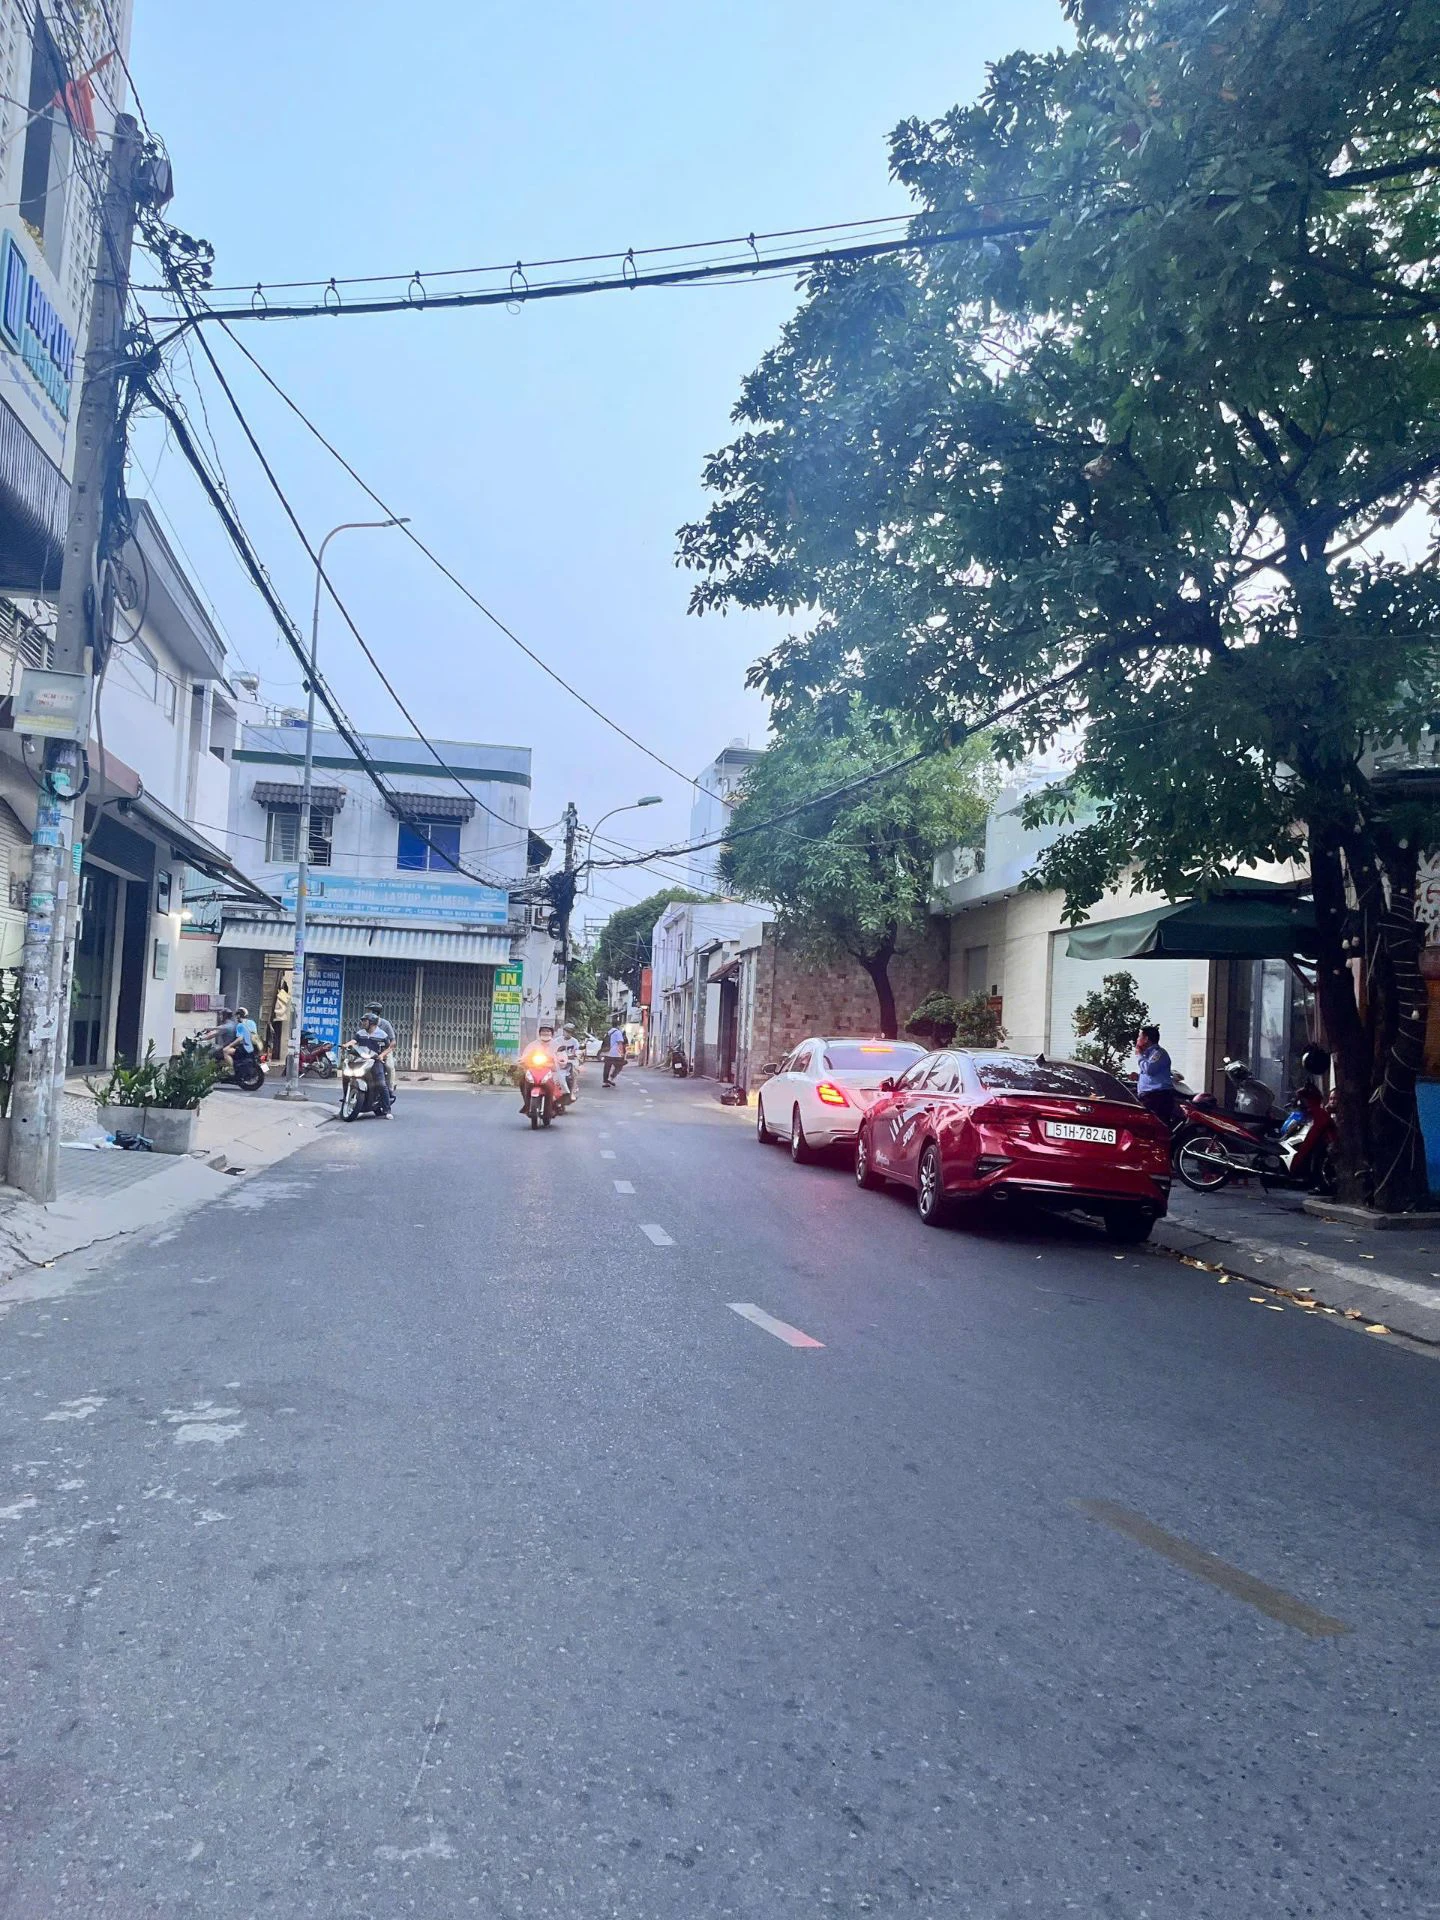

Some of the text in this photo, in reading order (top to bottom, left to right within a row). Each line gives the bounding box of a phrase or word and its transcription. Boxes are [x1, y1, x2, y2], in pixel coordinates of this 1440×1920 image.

[430, 895, 469, 907] CAMERA
[500, 972, 517, 985] IN
[305, 1007, 338, 1015] CAMERA
[1055, 1124, 1114, 1142] 51H-782.46
